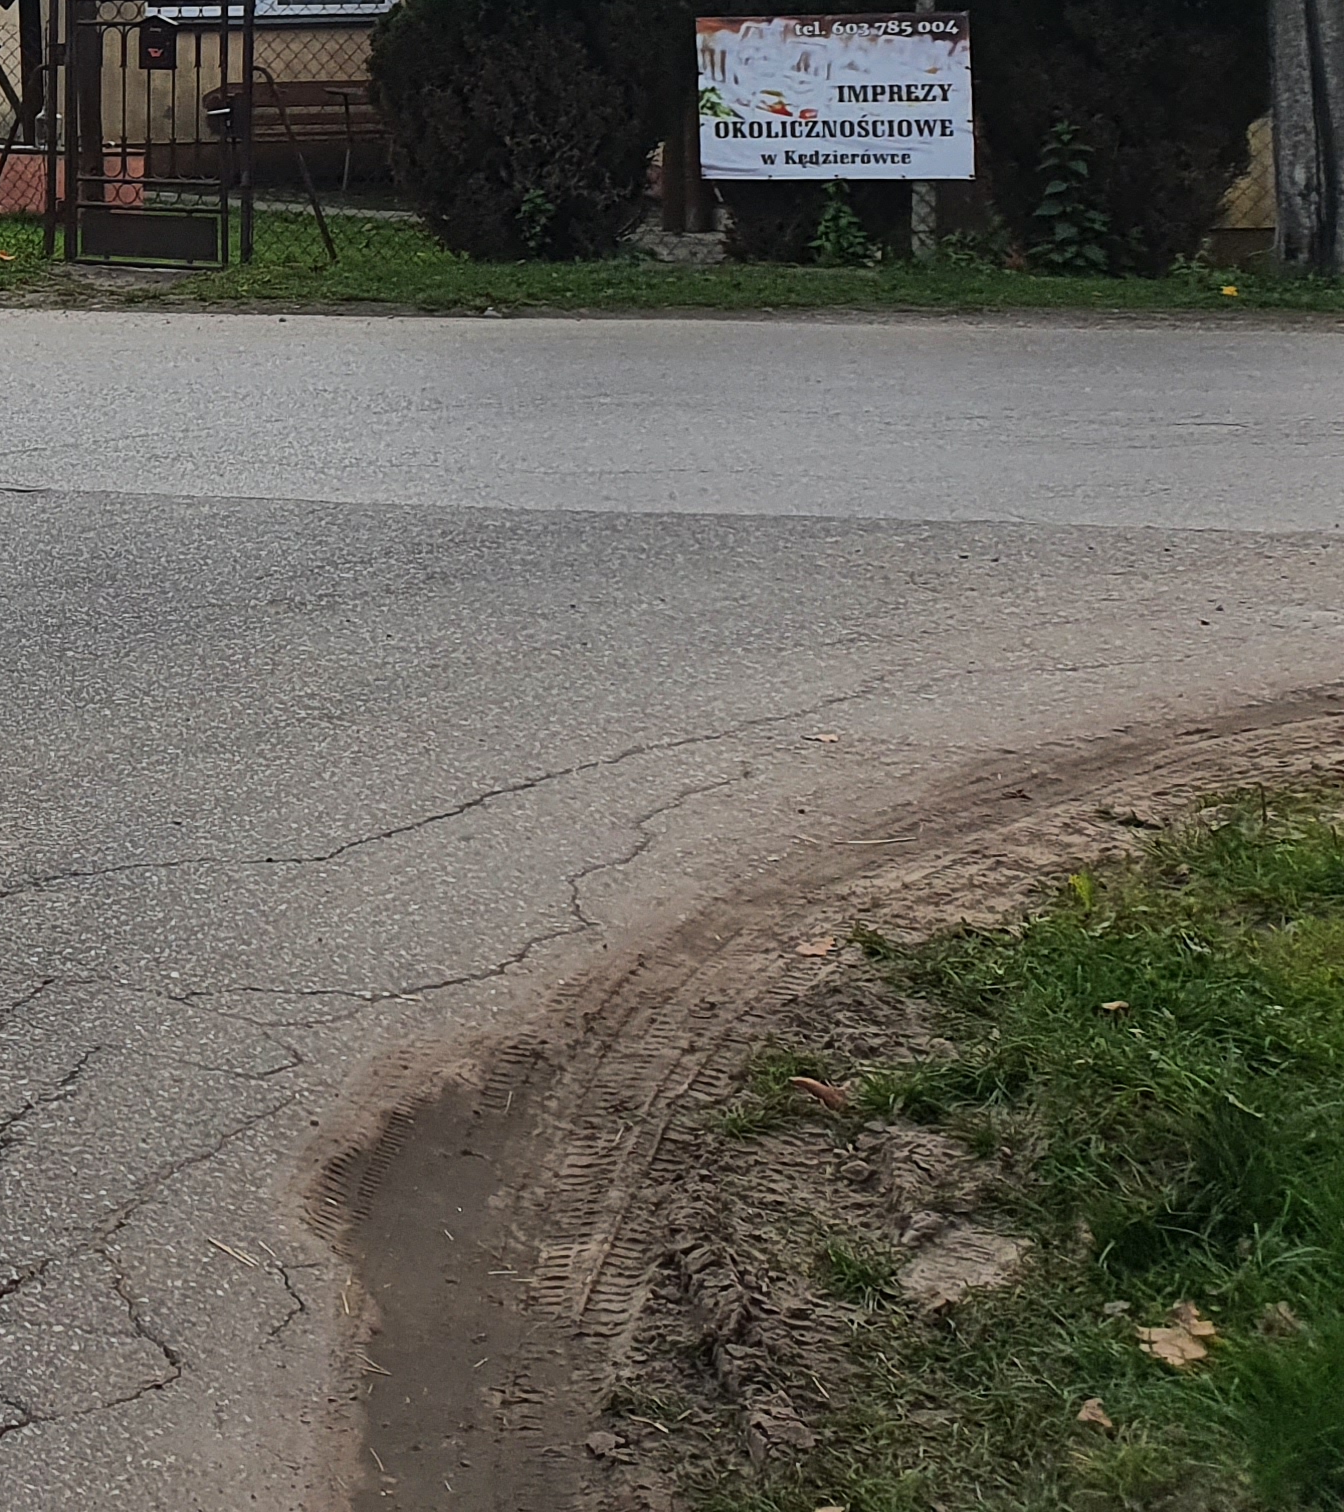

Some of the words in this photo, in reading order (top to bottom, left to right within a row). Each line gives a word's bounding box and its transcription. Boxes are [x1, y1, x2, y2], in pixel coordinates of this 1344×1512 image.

[795, 21, 826, 36] tel.
[832, 21, 870, 37] 603
[875, 20, 913, 37] 785
[918, 20, 959, 35] 004
[837, 84, 953, 103] IMPREZY
[714, 114, 954, 139] OKOLICZNOŚCIOWE
[761, 152, 776, 165] w
[784, 149, 912, 168] Kędzierówce
